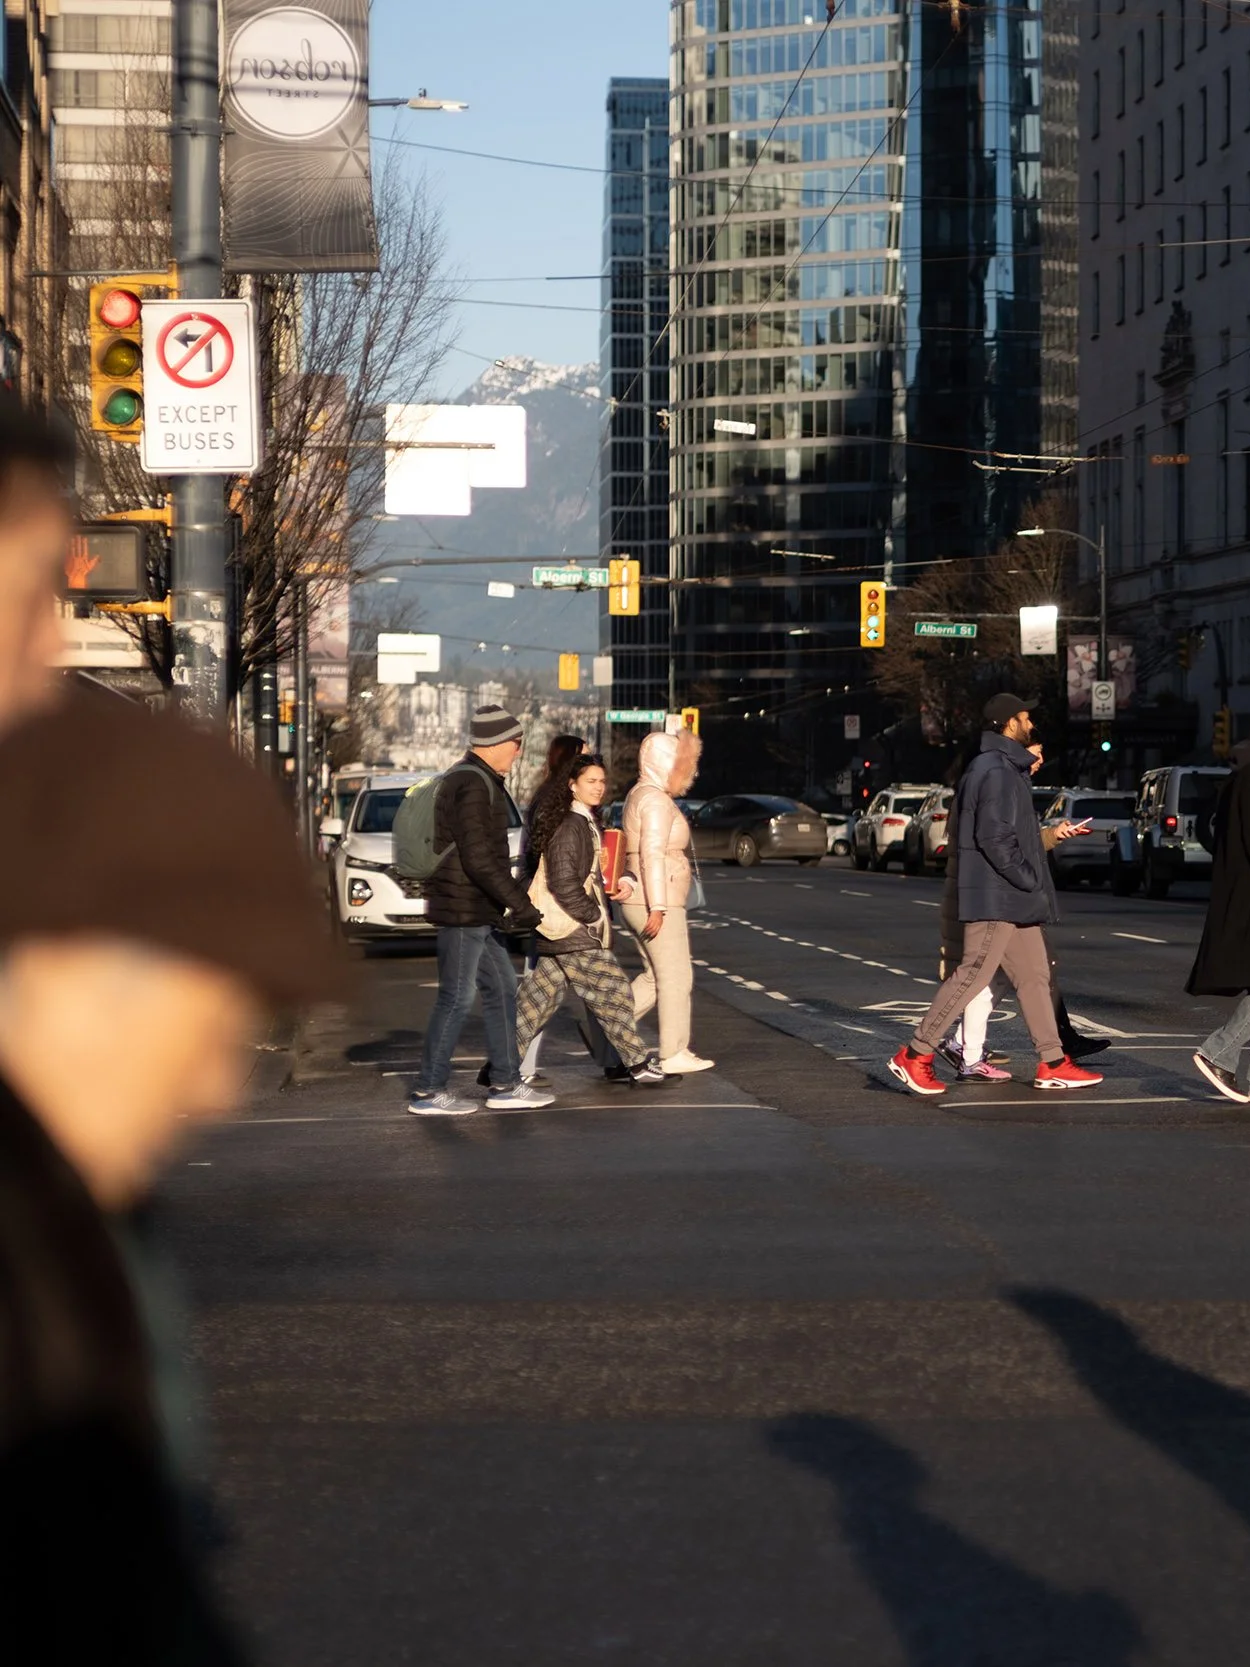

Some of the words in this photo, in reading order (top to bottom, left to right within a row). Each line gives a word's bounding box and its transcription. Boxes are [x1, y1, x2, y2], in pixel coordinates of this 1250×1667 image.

[158, 405, 238, 424] EXCEPT
[164, 431, 235, 450] BUSES
[588, 572, 604, 584] St
[919, 624, 956, 635] Alberni
[960, 626, 972, 636] St
